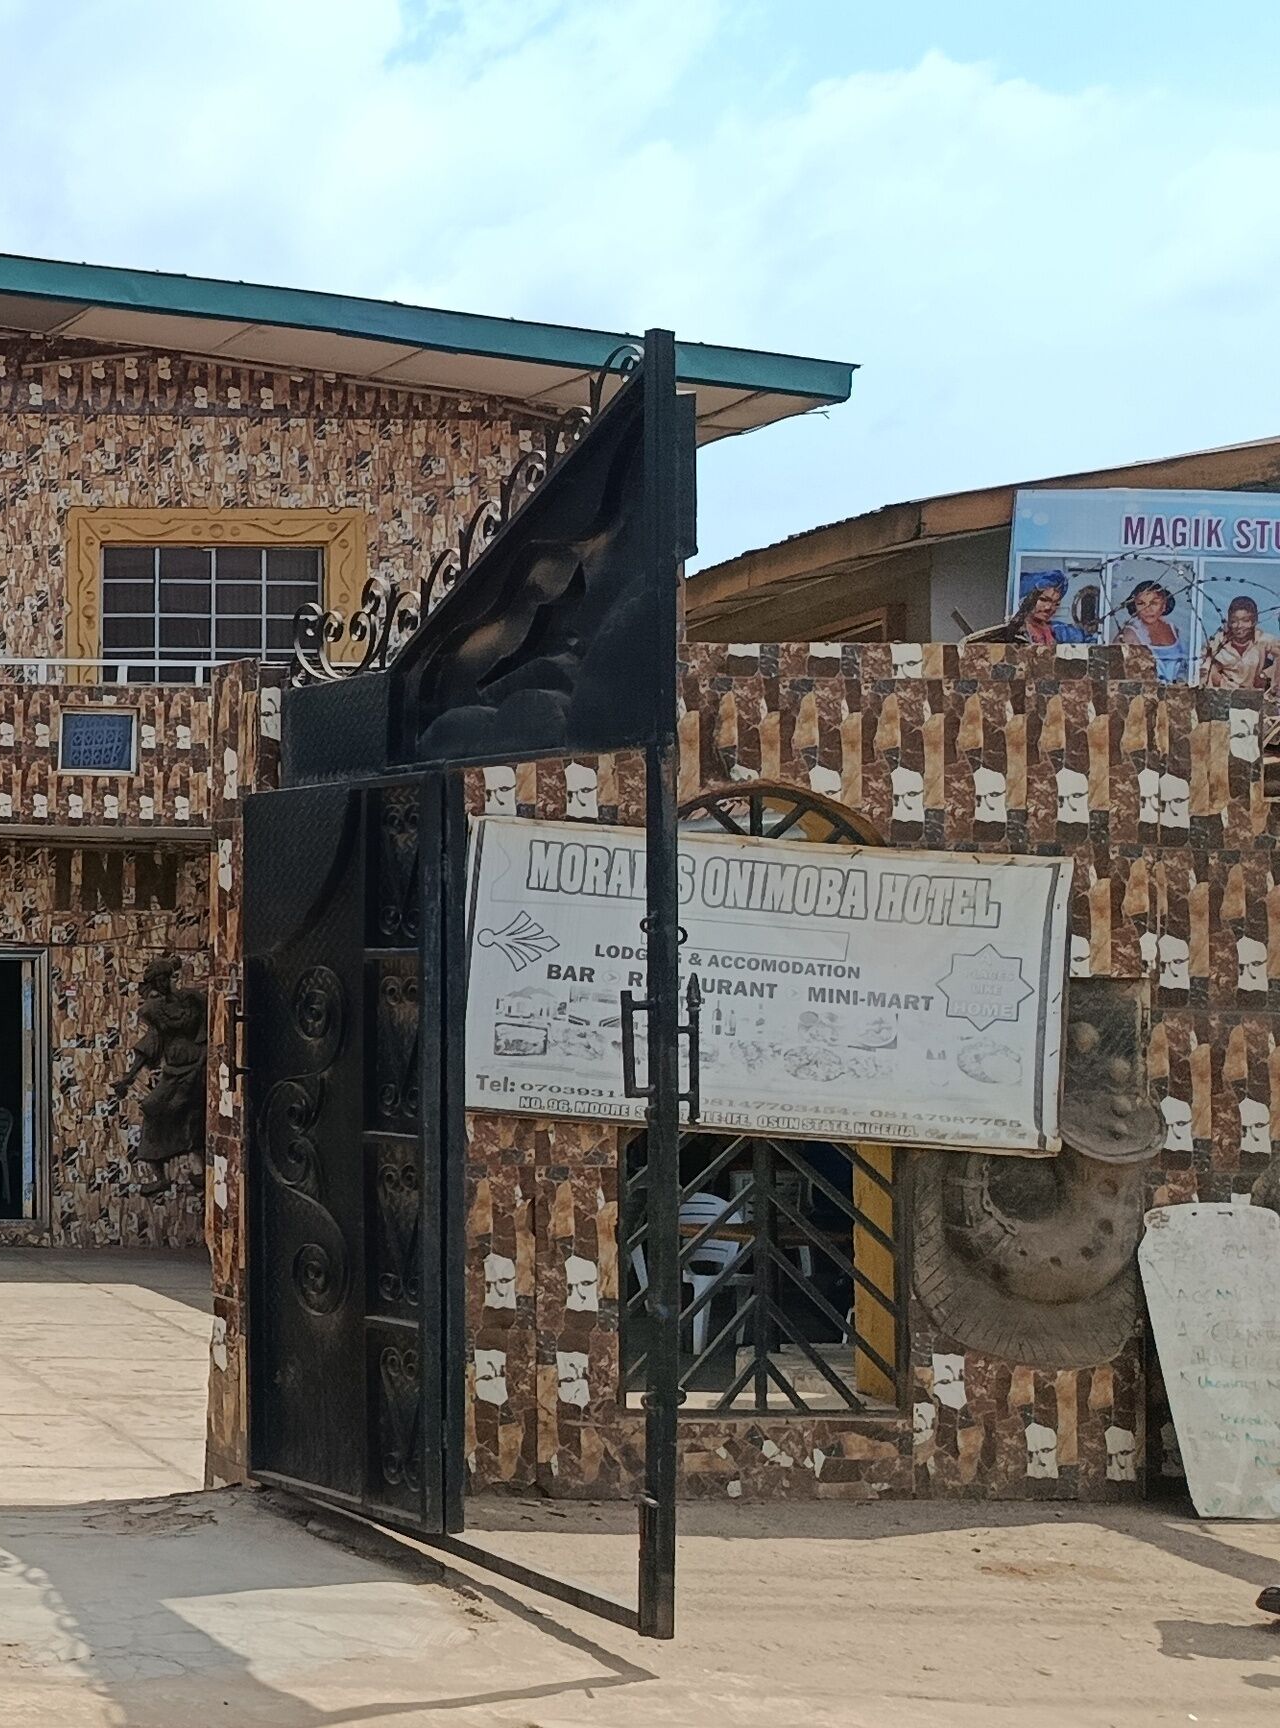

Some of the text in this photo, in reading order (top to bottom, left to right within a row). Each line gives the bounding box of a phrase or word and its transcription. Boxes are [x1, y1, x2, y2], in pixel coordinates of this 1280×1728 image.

[1122, 514, 1280, 551] MAGIK ST
[54, 848, 177, 912] INN
[526, 839, 1002, 929] MORAS ONIMOBA HOTEL
[546, 963, 595, 983] BAR
[595, 943, 861, 979] LODGG & ACCOMODATION
[627, 970, 778, 999] RURANT
[807, 986, 935, 1012] MINI-MART
[951, 1000, 1014, 1019] HOME
[476, 1074, 515, 1093] Tel:
[519, 1095, 545, 1110] NO.
[574, 1101, 630, 1117] MOORE
[756, 1114, 800, 1130] OSUN
